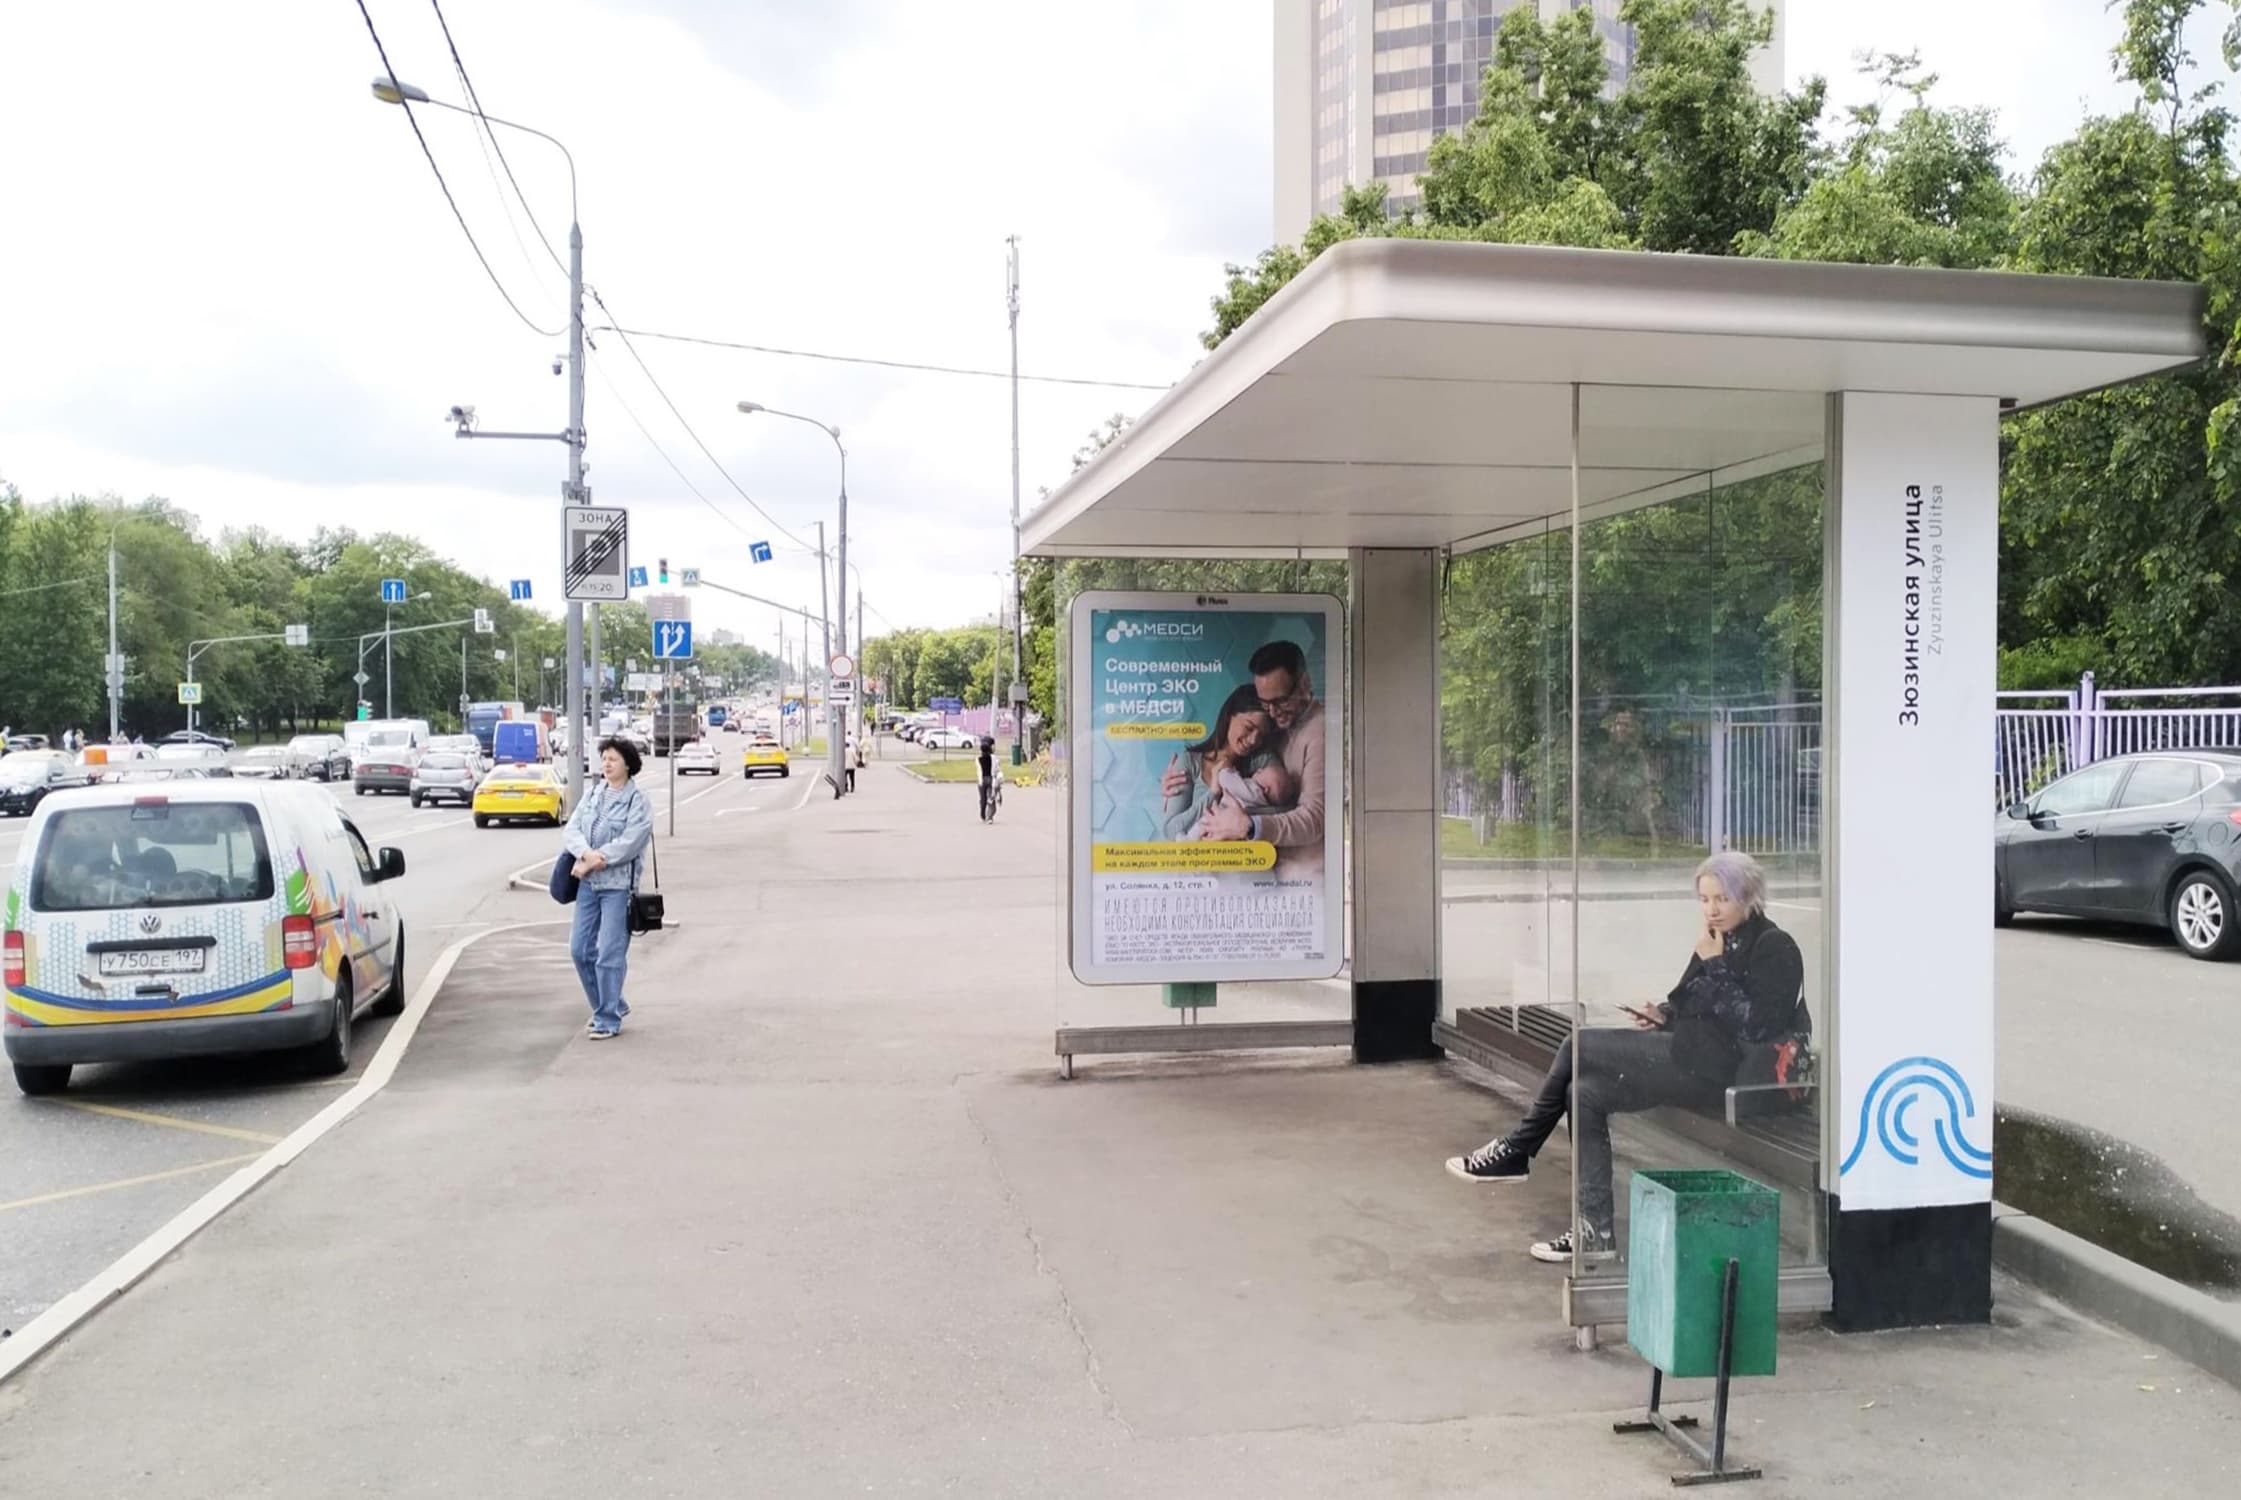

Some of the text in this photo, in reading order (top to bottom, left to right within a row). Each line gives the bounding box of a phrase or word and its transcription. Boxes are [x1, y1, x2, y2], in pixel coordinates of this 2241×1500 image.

[578, 512, 613, 524] ЗОНА
[1927, 484, 1945, 656] Zyuzinskaya Ulitsa
[1899, 484, 1925, 726] Зюзинская улица
[1105, 658, 1222, 675] Современный
[1105, 679, 1200, 696] Центр ЭКО
[1105, 700, 1185, 717] в МЕДСИ
[1105, 847, 1254, 857] Максимальная эффективность
[1119, 861, 1158, 869] каждом
[1188, 859, 1242, 868] программы
[1245, 857, 1267, 866] ЭКО
[1104, 895, 1313, 914] ИМЕЮТСЯ ПРОТИВОПОКАЗАНИЯ
[1104, 911, 1313, 932] НЕОБХОДИМА КОНСУЛЬТАЦИЯ СПЕЦИАЛИСТА
[175, 949, 200, 962] 197
